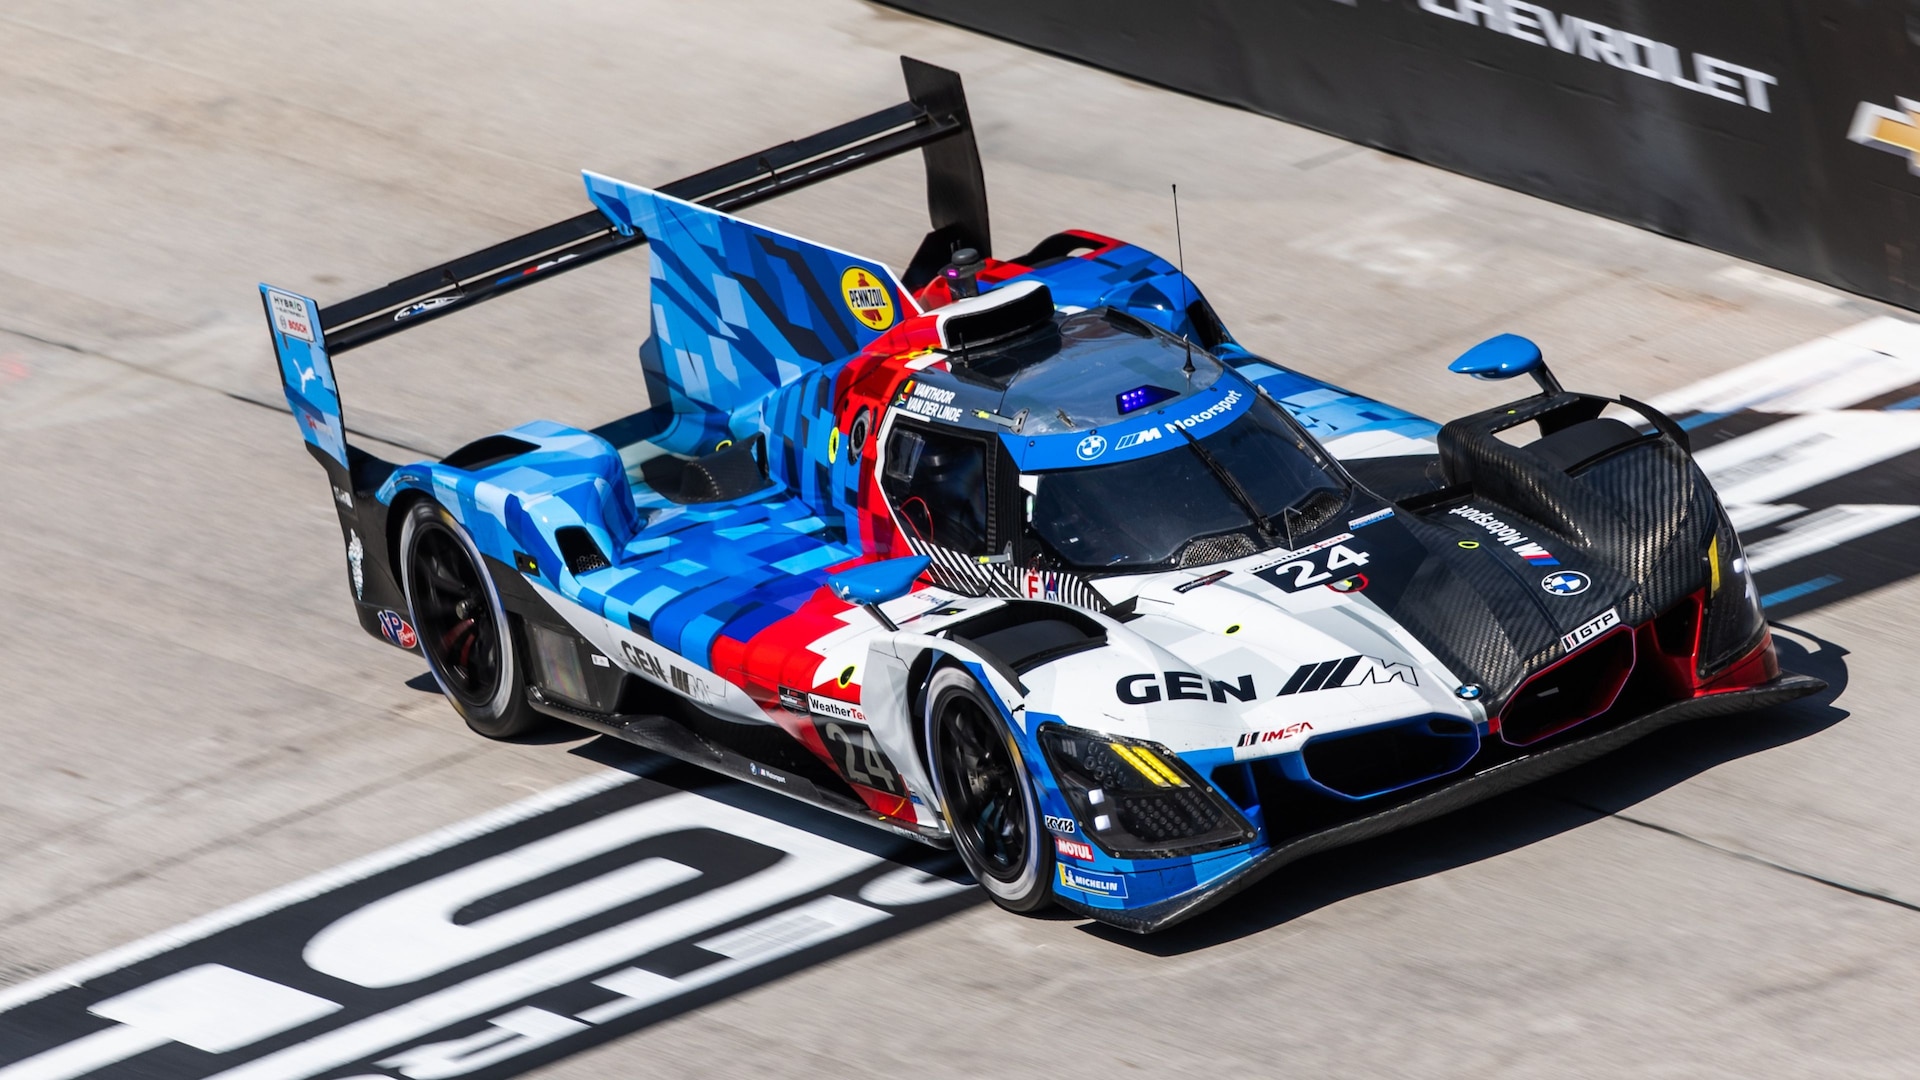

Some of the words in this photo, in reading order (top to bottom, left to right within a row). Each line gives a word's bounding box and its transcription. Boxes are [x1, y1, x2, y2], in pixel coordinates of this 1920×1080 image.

[273, 295, 303, 312] HYBRID
[849, 288, 886, 309] PENNZOIL
[287, 319, 308, 333] BOSCH
[914, 382, 956, 405] VANTHOOR
[906, 396, 923, 412] VAN
[922, 401, 939, 418] DER
[936, 405, 963, 423] LINDE
[1164, 389, 1243, 434] Motorsport
[1448, 505, 1529, 546] Motorsport
[1275, 544, 1371, 588] 24
[1028, 575, 1039, 599] F
[1579, 612, 1614, 640] GTP
[621, 640, 669, 684] GEN
[1115, 671, 1257, 706] GEN
[1261, 721, 1315, 743] IMSA
[825, 722, 896, 792] 24
[1058, 839, 1093, 860] MOTUL
[1075, 875, 1119, 892] MICHELIN
